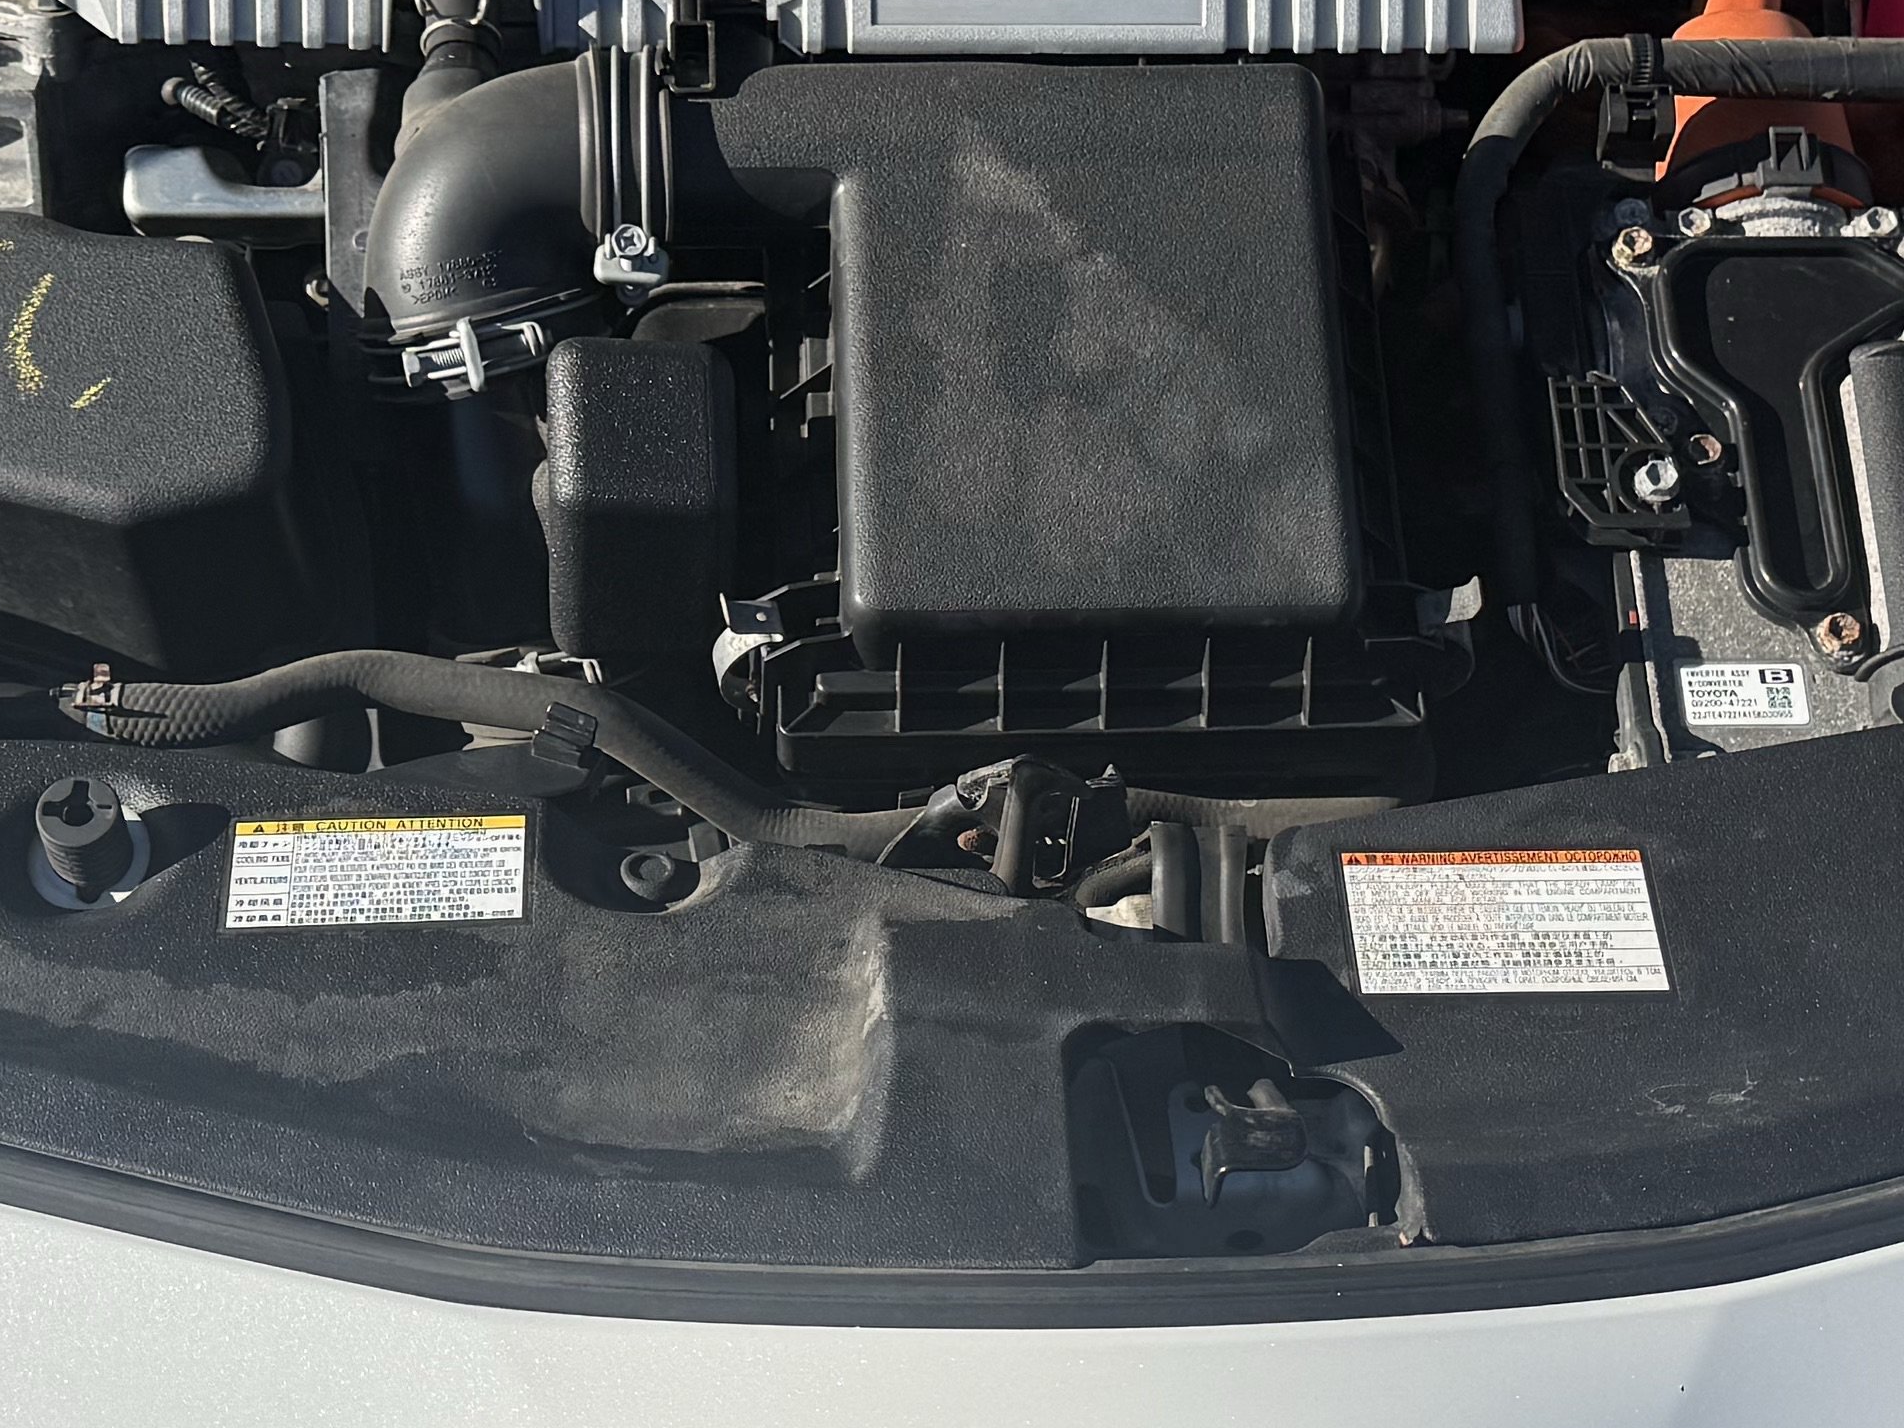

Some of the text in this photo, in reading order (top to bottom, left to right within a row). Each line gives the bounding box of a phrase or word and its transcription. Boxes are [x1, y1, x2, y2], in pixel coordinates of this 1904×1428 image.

[1688, 689, 1738, 698] TOYOTA
[316, 821, 387, 832] CAUTION
[396, 818, 484, 830] ATTENTION
[1400, 853, 1456, 864] WARNING
[1461, 851, 1560, 863] AVERTISSEMENT
